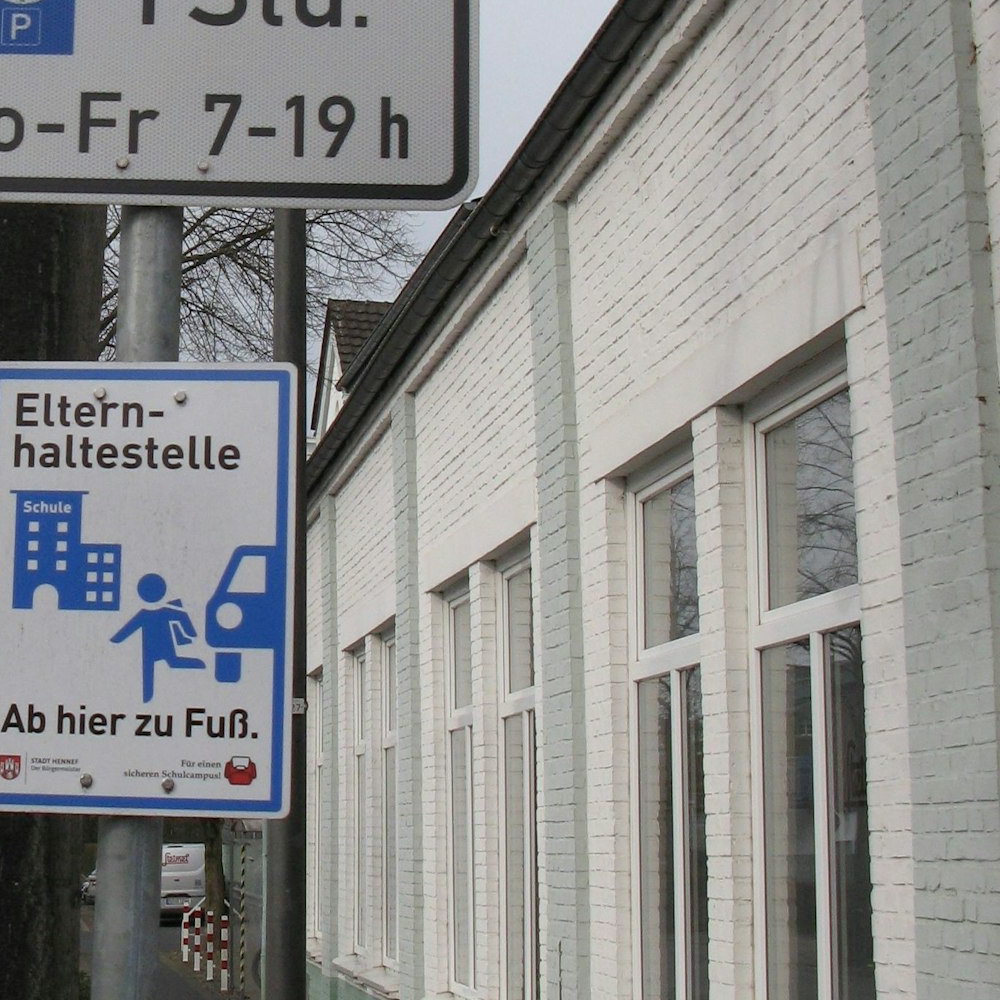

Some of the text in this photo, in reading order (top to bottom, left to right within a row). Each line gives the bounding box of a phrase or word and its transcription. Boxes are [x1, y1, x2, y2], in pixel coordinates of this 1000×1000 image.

[10, 13, 32, 40] P
[15, 393, 164, 428] Eltern-
[13, 434, 241, 470] haltestelle
[23, 500, 72, 514] Schule
[0, 703, 259, 739] Ab hier zu Fuß.
[123, 768, 222, 780] sicheren Schulcampus!
[181, 759, 221, 768] Für einen
